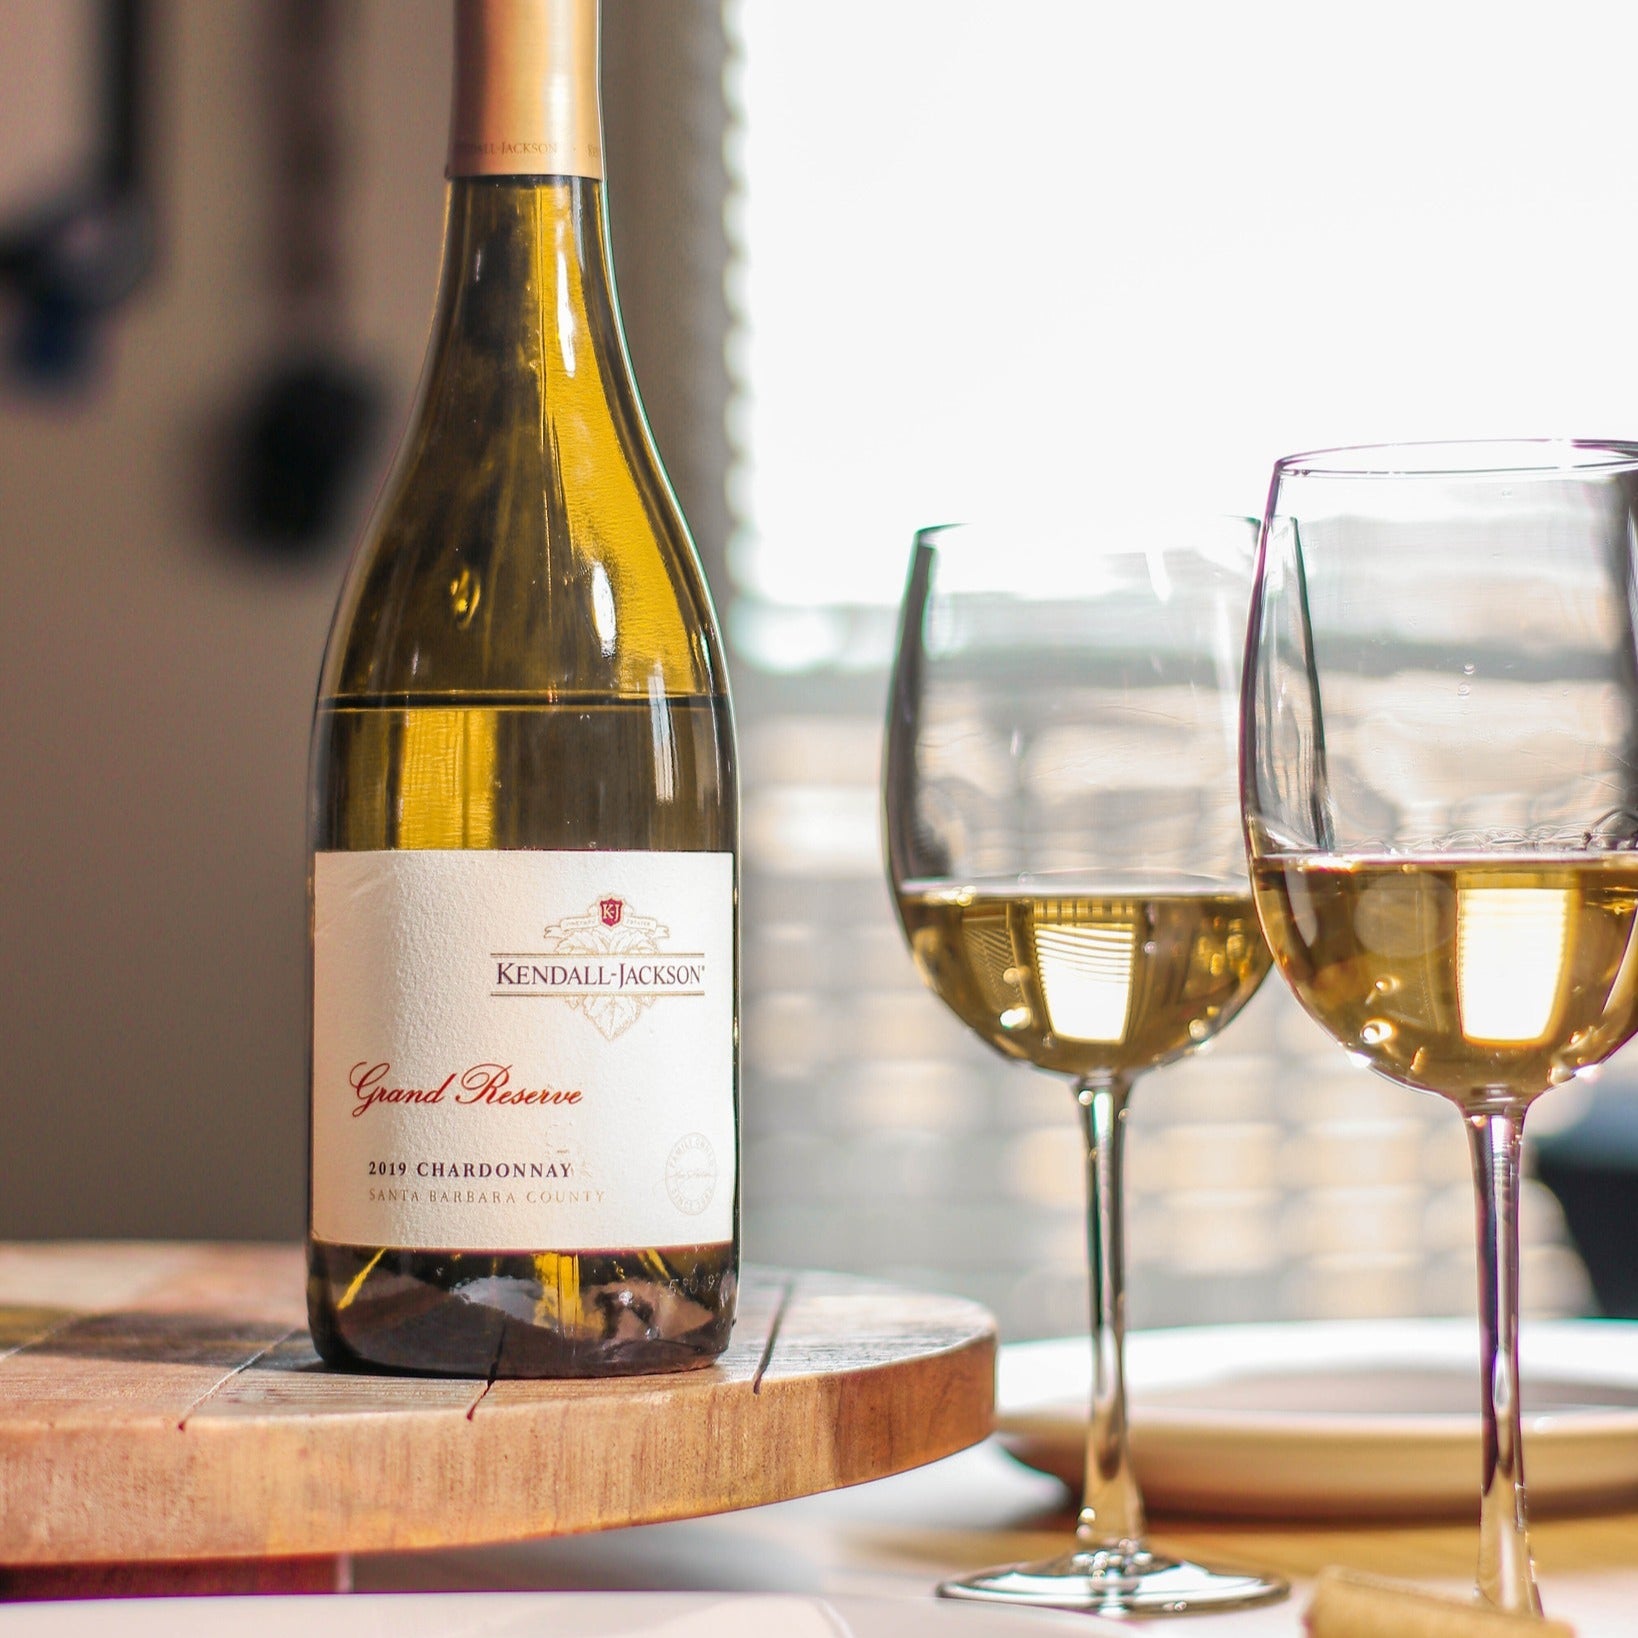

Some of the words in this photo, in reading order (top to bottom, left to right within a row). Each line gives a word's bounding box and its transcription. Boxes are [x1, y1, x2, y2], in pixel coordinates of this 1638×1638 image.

[349, 1061, 457, 1118] Grand
[455, 1063, 584, 1104] Reserve
[368, 1161, 407, 1176] 2019
[416, 1161, 572, 1178] CHARDONNAY
[369, 1187, 419, 1202] SANTA
[429, 1189, 516, 1204] BARBARA
[525, 1190, 605, 1203] COUNTY
